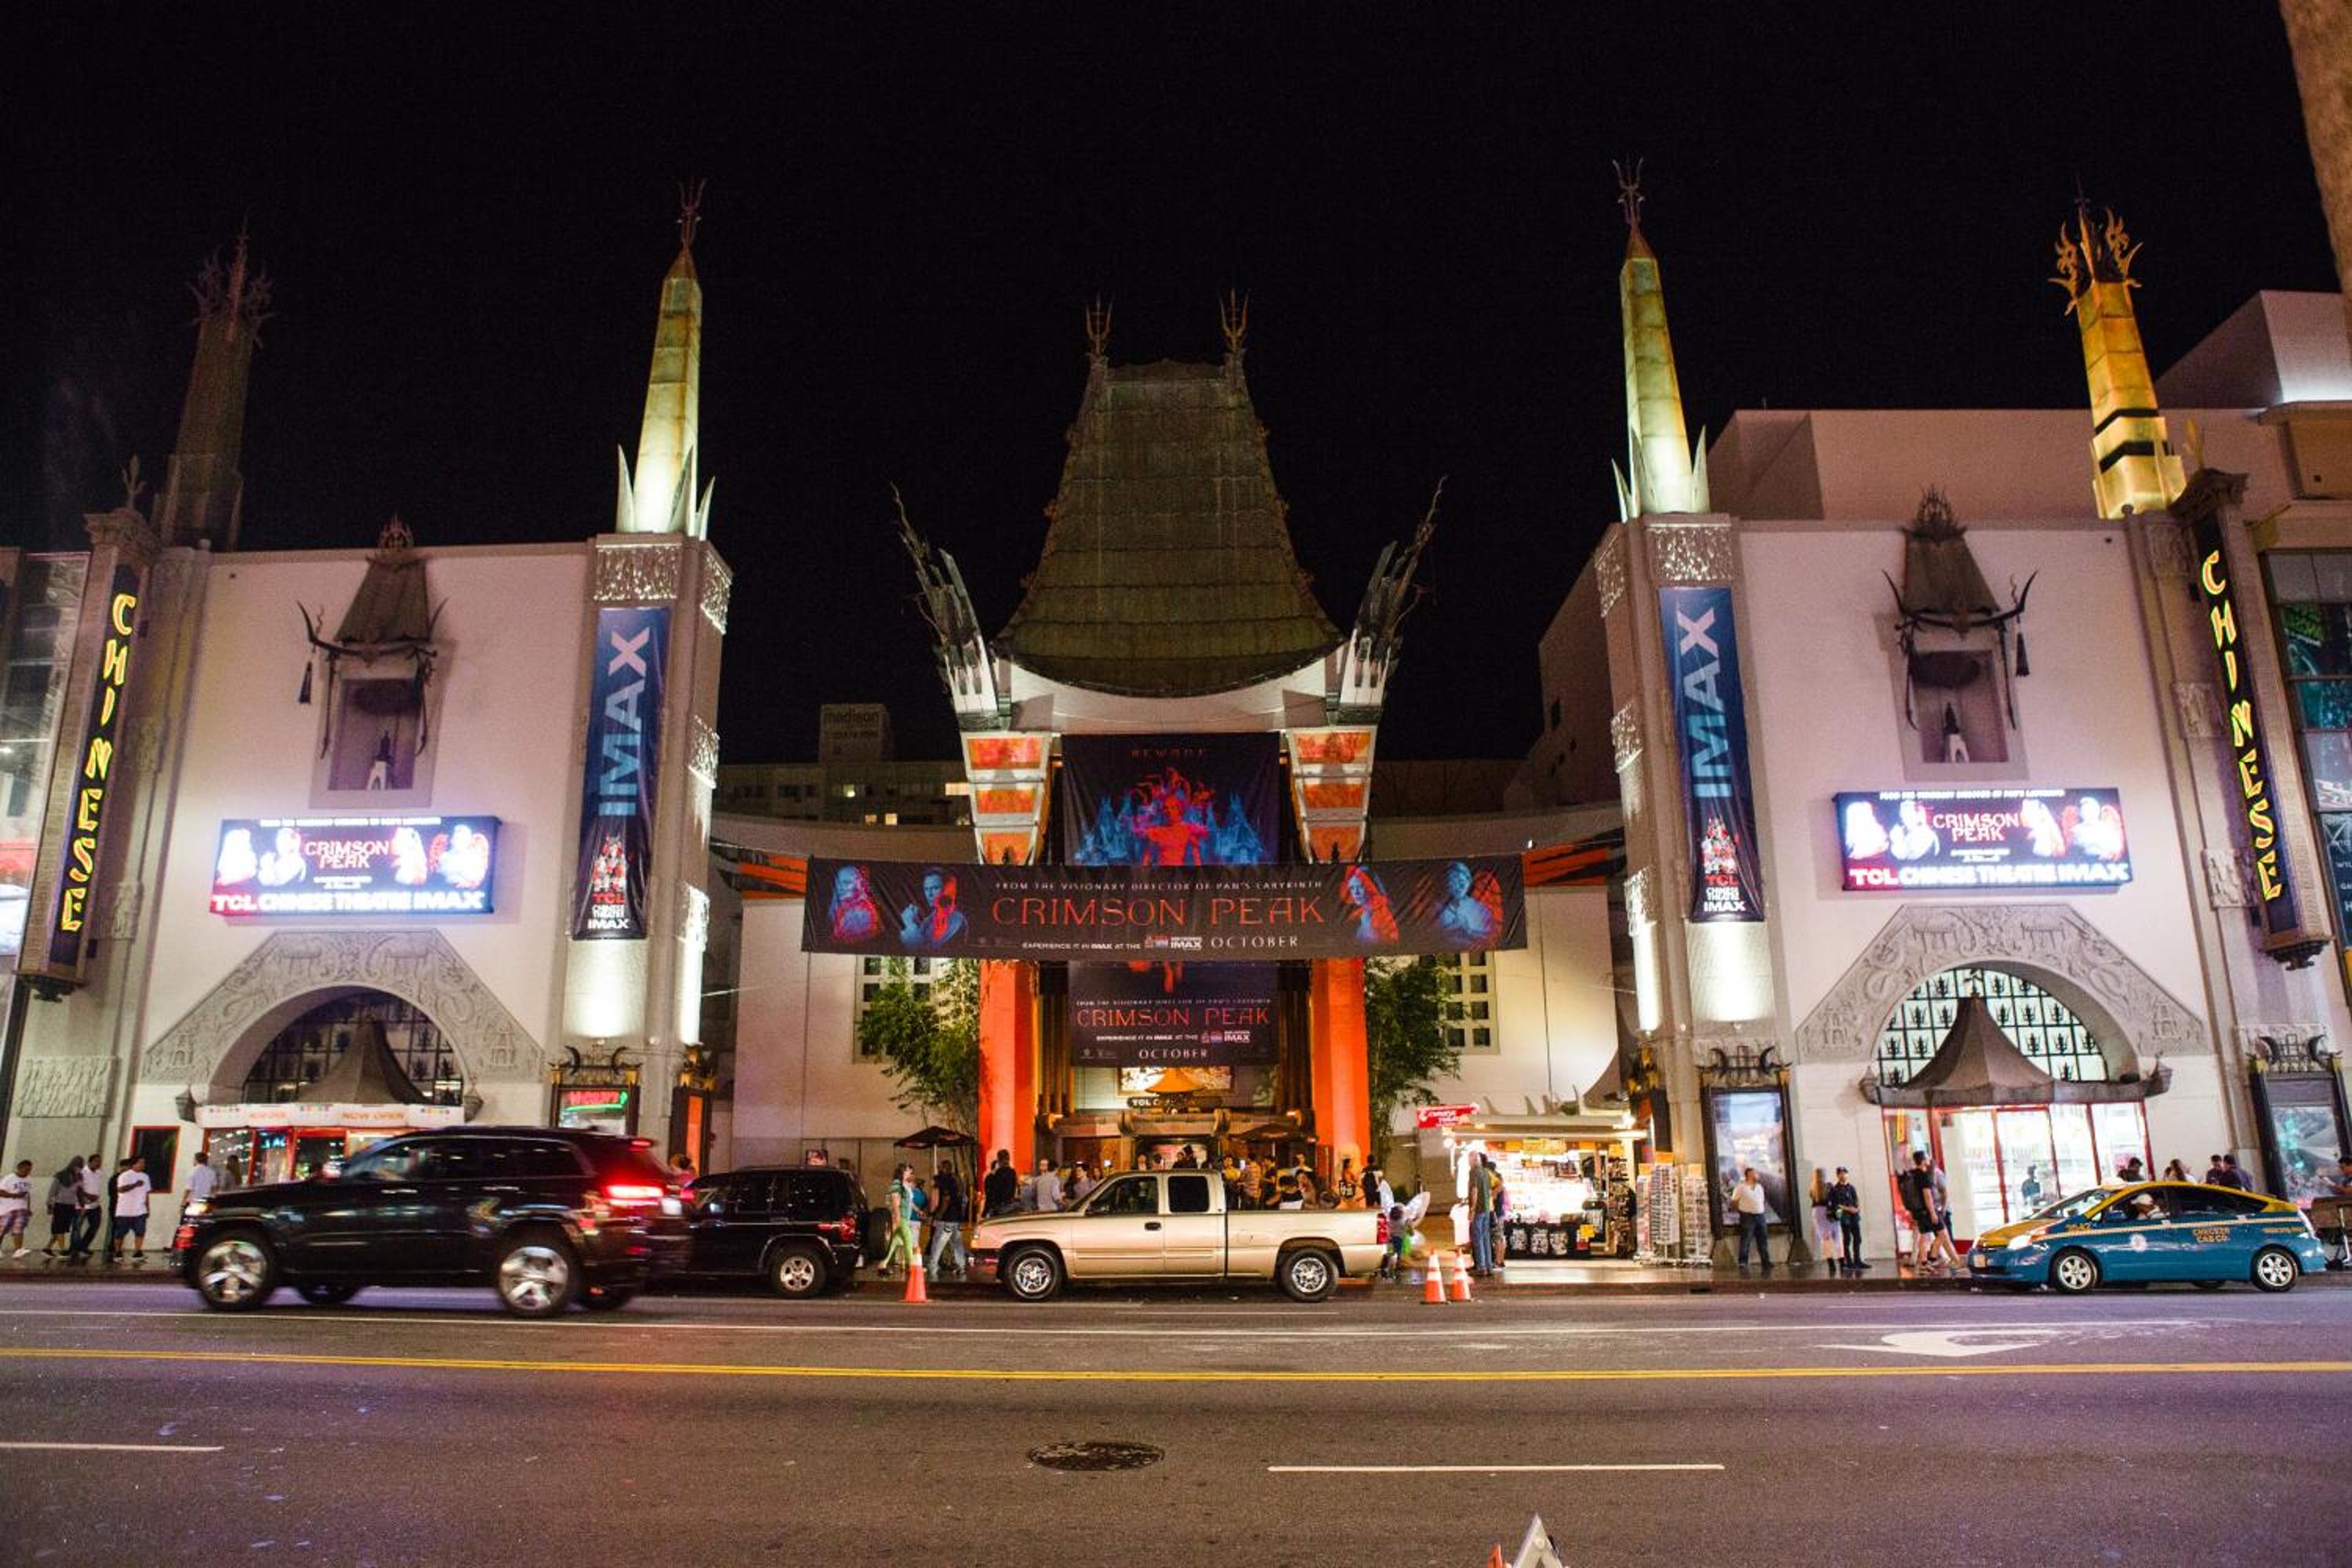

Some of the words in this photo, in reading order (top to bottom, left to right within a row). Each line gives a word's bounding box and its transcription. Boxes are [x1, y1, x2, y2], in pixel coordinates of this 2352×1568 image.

[1677, 608, 1733, 798] IMAX
[598, 626, 650, 816] IMAX
[2201, 550, 2282, 902] CHINESE
[61, 593, 137, 932] CHINESE
[1933, 813, 2020, 829] CRIMSON
[1951, 828, 2005, 842] PEAK
[304, 840, 390, 856] CRIMSON
[319, 853, 370, 869] PEAK
[1705, 874, 1739, 887] TCL
[1849, 869, 1900, 886] TCL
[2057, 862, 2129, 881] IMAX
[212, 894, 257, 911] TCL
[414, 891, 485, 909] IMAX
[592, 892, 626, 904] TCL
[993, 896, 1185, 926] CRIMSON
[1211, 895, 1325, 926] PEAK
[1704, 901, 1746, 912] IMAX
[587, 918, 629, 929] IMAX
[1210, 936, 1298, 949] OCTOBER
[1077, 1008, 1190, 1028] CRIMSON
[1203, 1007, 1269, 1026] PEAK
[1138, 1048, 1208, 1058] OCTOBER
